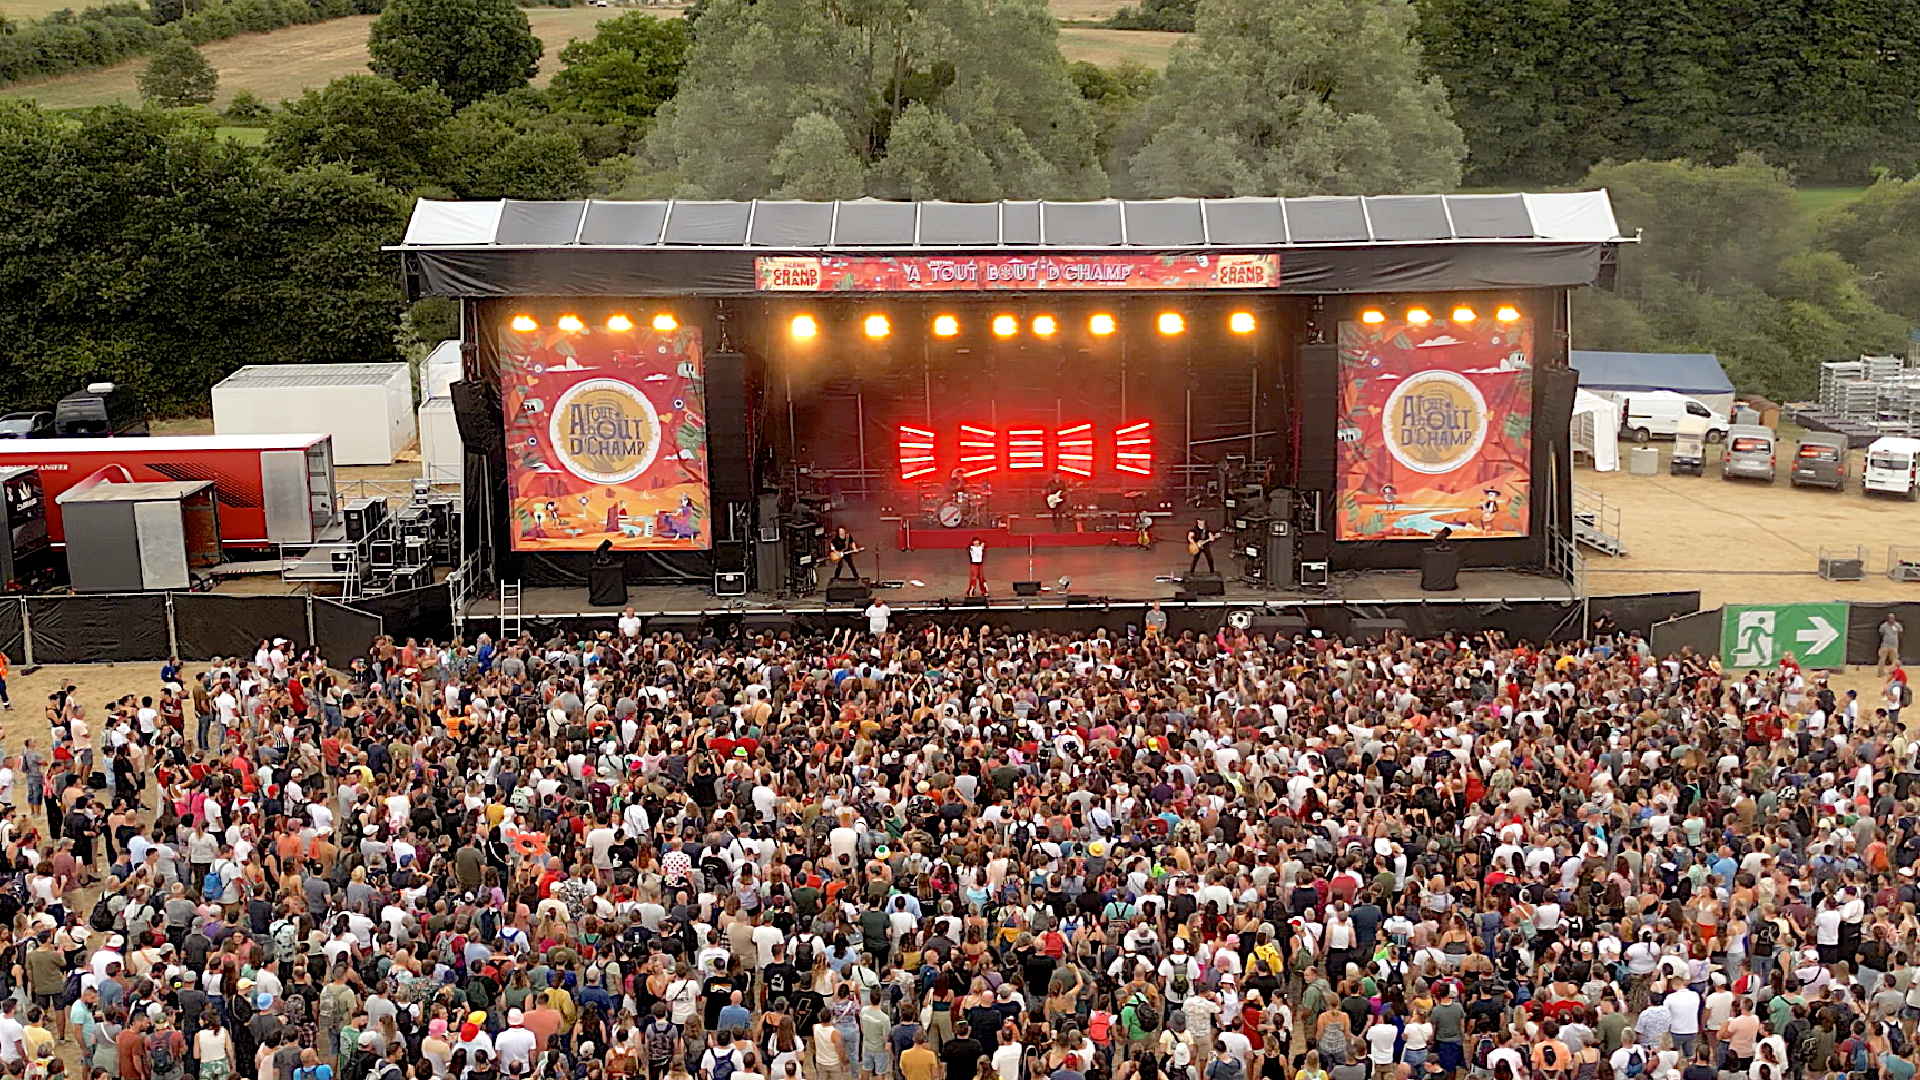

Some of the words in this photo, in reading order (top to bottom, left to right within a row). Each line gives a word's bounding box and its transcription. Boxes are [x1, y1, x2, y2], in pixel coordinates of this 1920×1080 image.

[773, 269, 817, 277] GRAND
[930, 263, 978, 282] TOUT
[987, 263, 1038, 282] BOUT
[1046, 263, 1131, 282] D'CHAMP
[1220, 266, 1264, 274] GRAND
[773, 277, 818, 286] CHAMP
[1220, 274, 1264, 284] CHAMP
[1401, 428, 1472, 446] D'CHAMP
[569, 437, 645, 455] D'CHAMP
